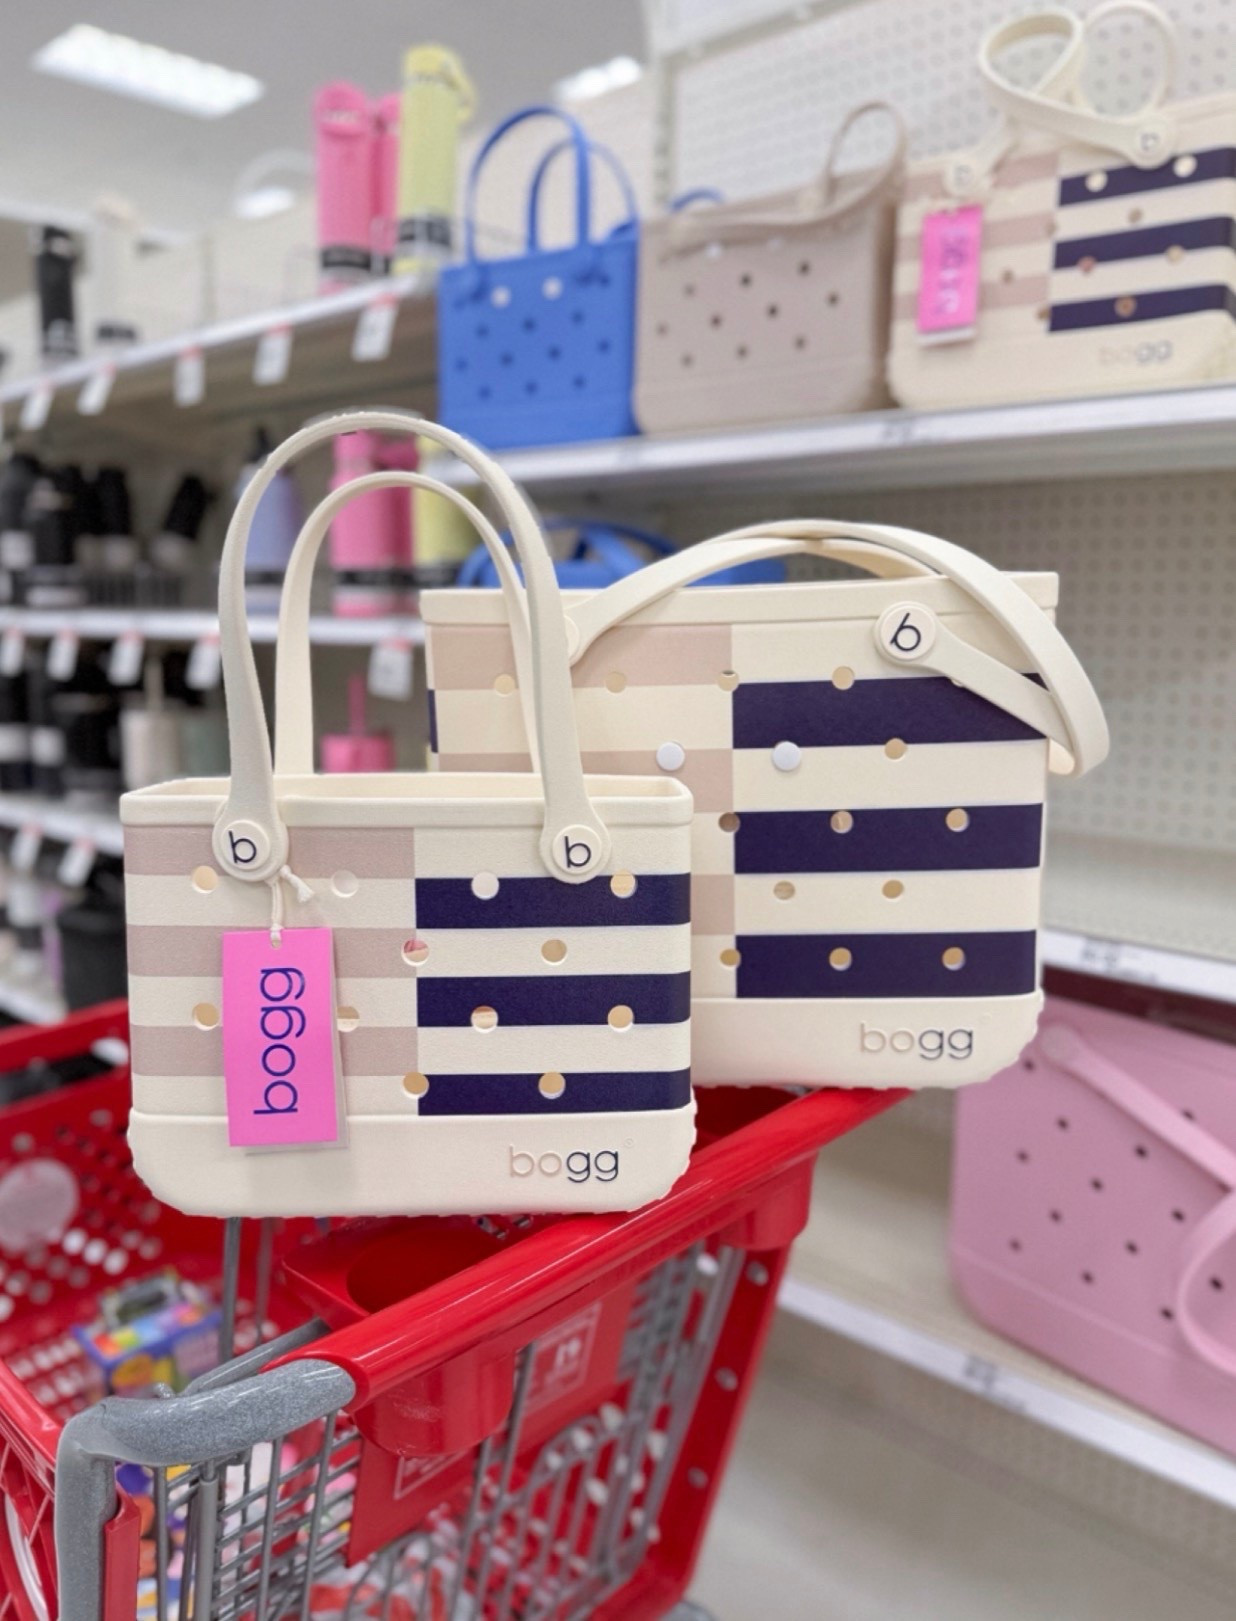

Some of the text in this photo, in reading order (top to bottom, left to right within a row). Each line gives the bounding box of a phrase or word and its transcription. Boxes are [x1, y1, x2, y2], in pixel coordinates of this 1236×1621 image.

[228, 830, 257, 864] b
[564, 835, 591, 868] b
[253, 967, 306, 1115] bogg
[860, 1022, 973, 1061] bogg
[509, 1145, 619, 1183] bogg
